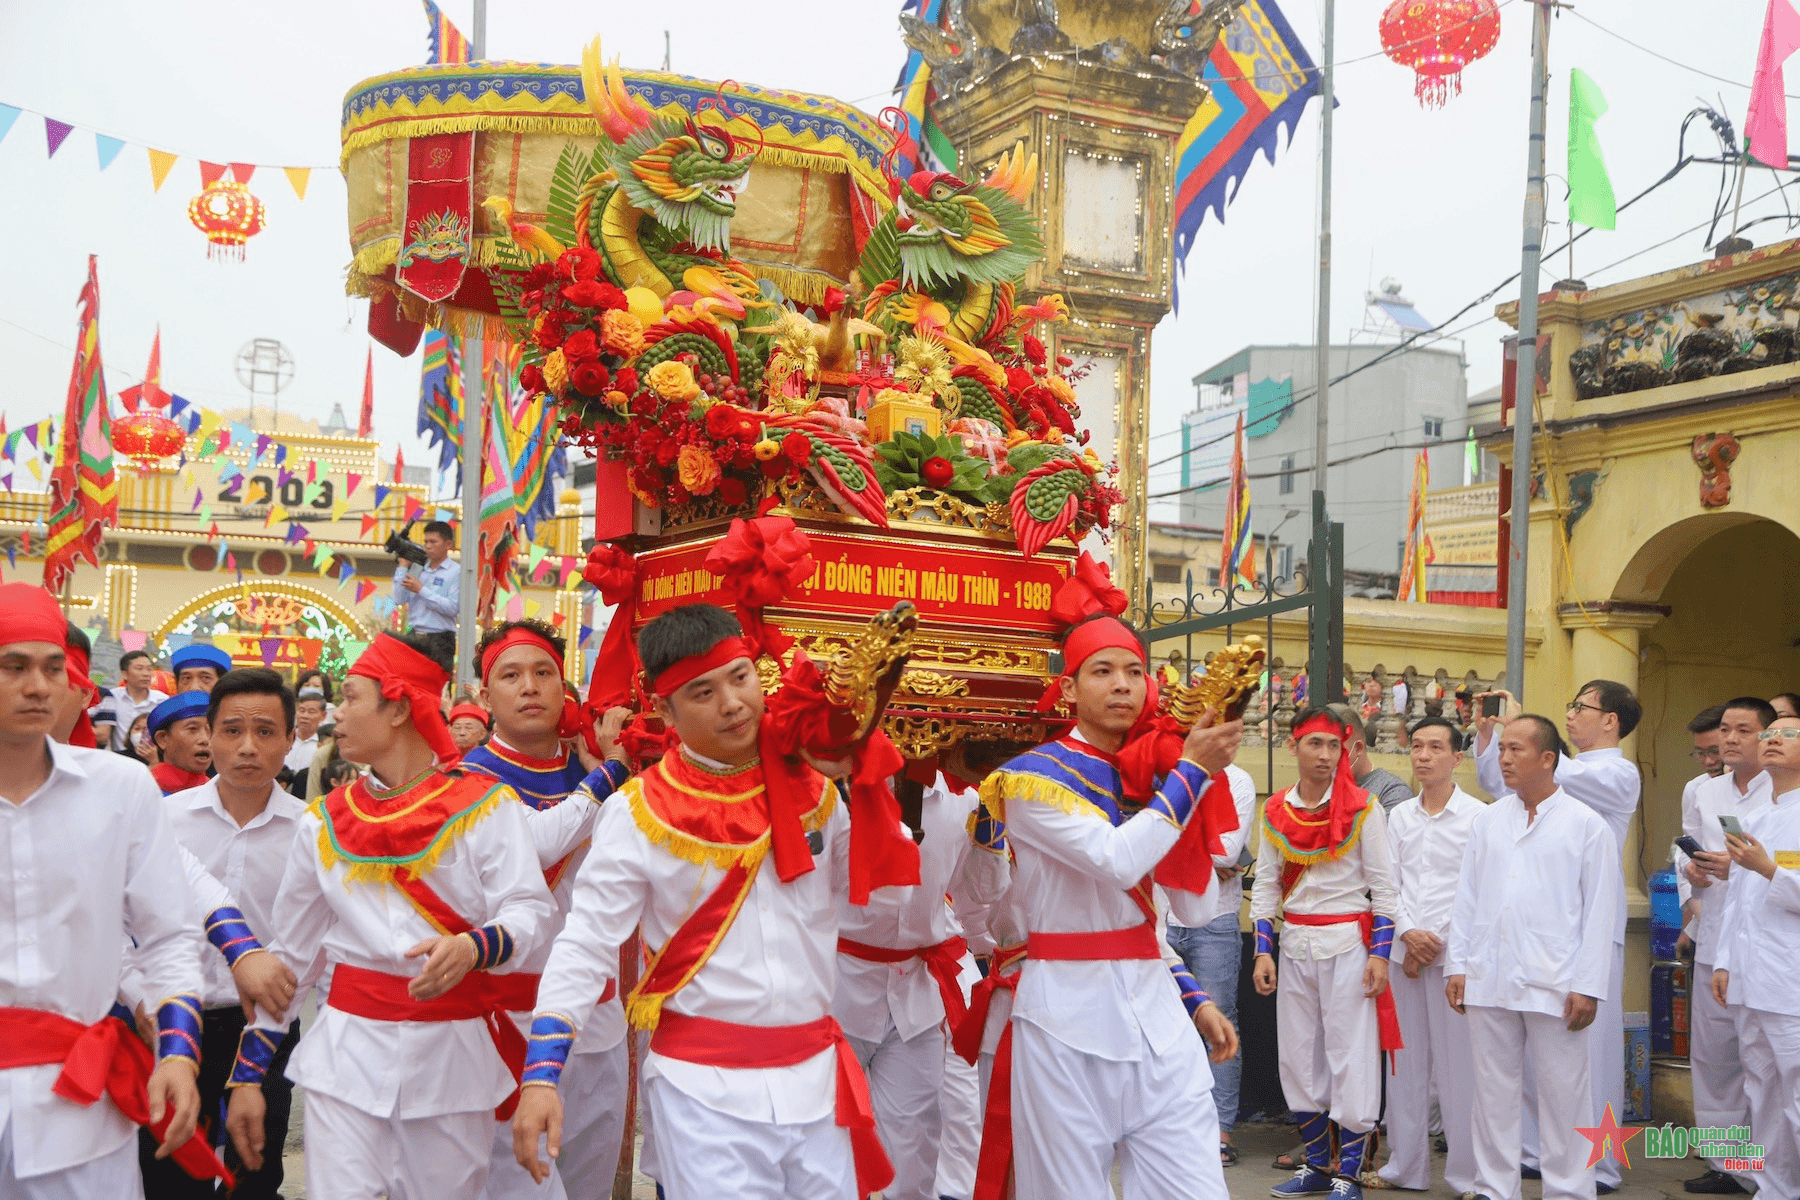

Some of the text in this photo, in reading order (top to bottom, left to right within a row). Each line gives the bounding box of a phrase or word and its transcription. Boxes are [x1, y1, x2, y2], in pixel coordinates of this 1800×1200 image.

[217, 475, 334, 509] 2003
[674, 566, 694, 597] NIÊN
[825, 551, 873, 596] ĐỒNG
[876, 562, 917, 599] NIÊN
[921, 565, 959, 609] MẬU
[962, 570, 1000, 607] THÌN
[1003, 591, 1011, 599] -
[1014, 580, 1052, 612] 1988
